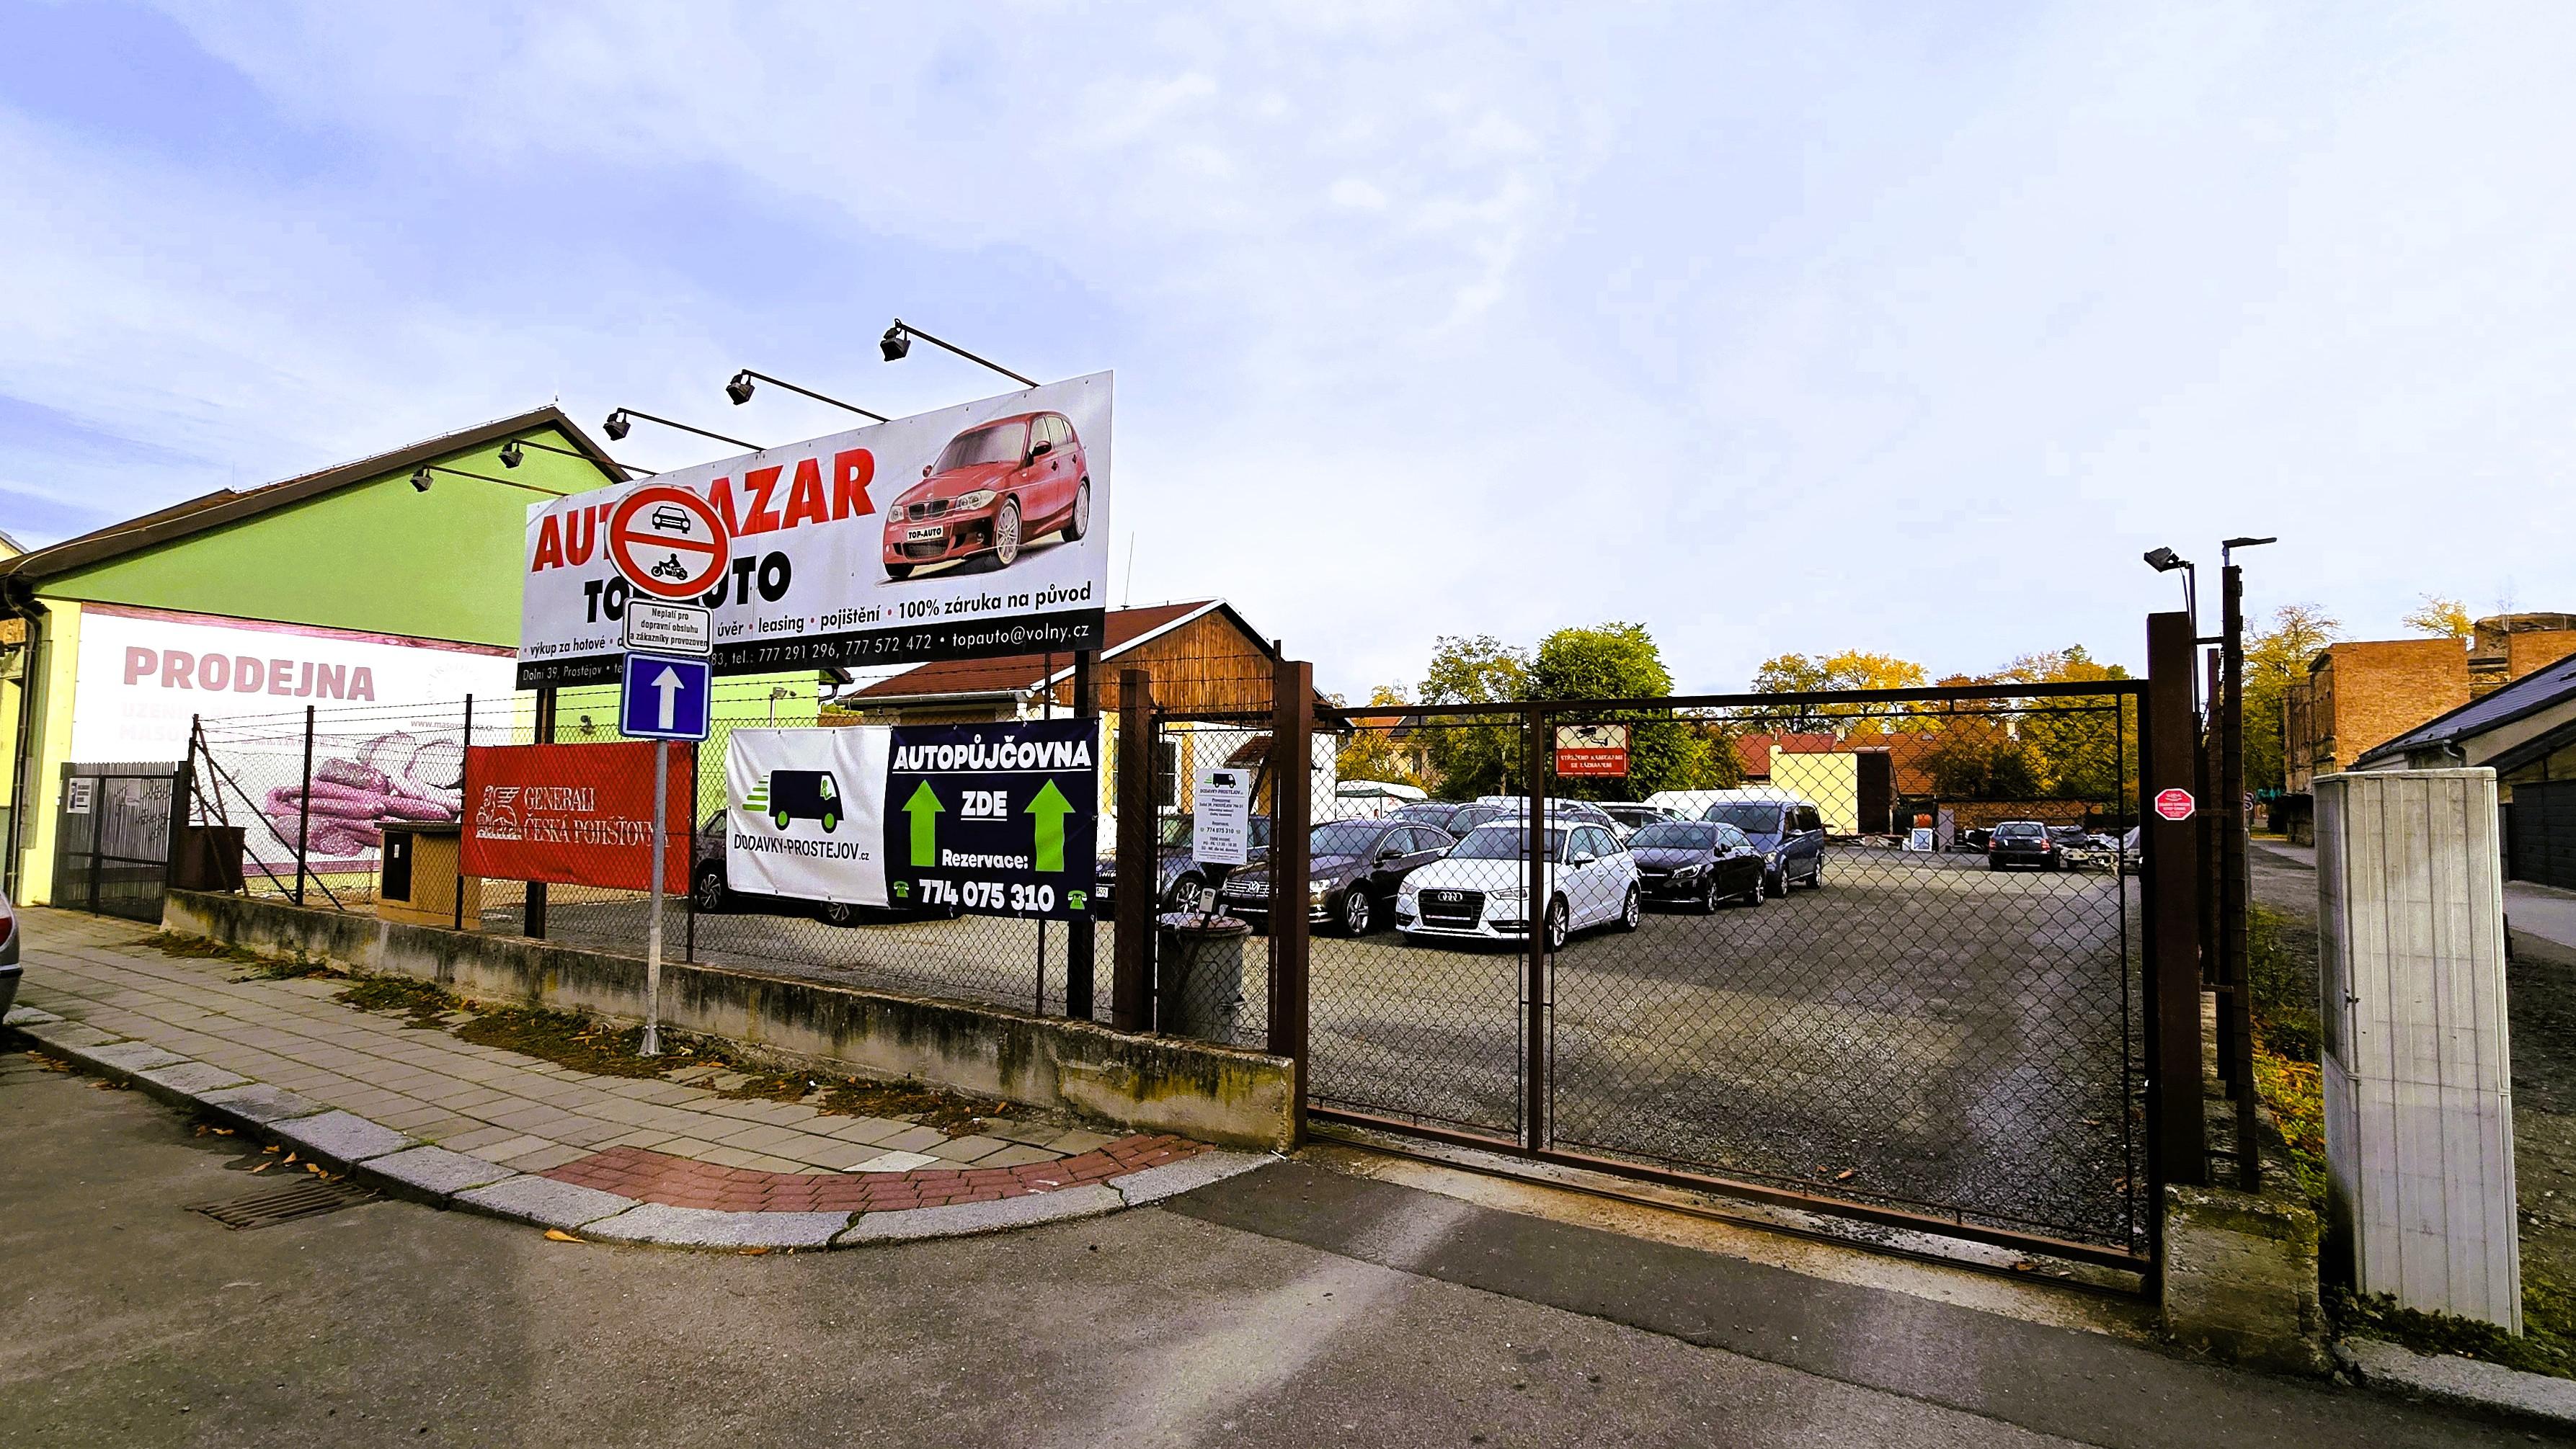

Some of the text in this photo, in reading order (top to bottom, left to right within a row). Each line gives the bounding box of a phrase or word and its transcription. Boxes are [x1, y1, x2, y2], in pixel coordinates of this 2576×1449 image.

[532, 448, 876, 572] AUAZAR
[908, 527, 942, 539] TOP-AUTO
[584, 550, 792, 624] TOUTO
[652, 607, 677, 619] Neplatí
[716, 581, 1091, 638] úvěr leasing pojištění 100% záruka na původ
[636, 633, 670, 644] zákazníky
[641, 620, 698, 633] dopravní obsluhu
[530, 641, 556, 659] výkup
[559, 643, 570, 653] za
[573, 635, 605, 651] hotové
[759, 647, 780, 662] 777
[785, 645, 806, 660] 291
[812, 642, 840, 659] 296,
[845, 640, 869, 656] 777
[874, 637, 900, 654] 572
[906, 634, 932, 650] 472
[952, 623, 1089, 649] topauto@volny.cz
[123, 646, 375, 701] PRODEJNA
[523, 668, 544, 681] Dolní
[546, 667, 560, 679] 39,
[563, 664, 603, 678] Prostějov
[892, 734, 1092, 770] AUTOPŮJČOVNA
[523, 785, 595, 812] GENERALI
[961, 790, 1008, 817] ZDE
[524, 813, 570, 843] ČESKÁ
[734, 834, 870, 861] DODAVKY-PROSTEJOV.cz
[941, 849, 1029, 870] Rezervace:
[919, 878, 1055, 911] 774 075 310
